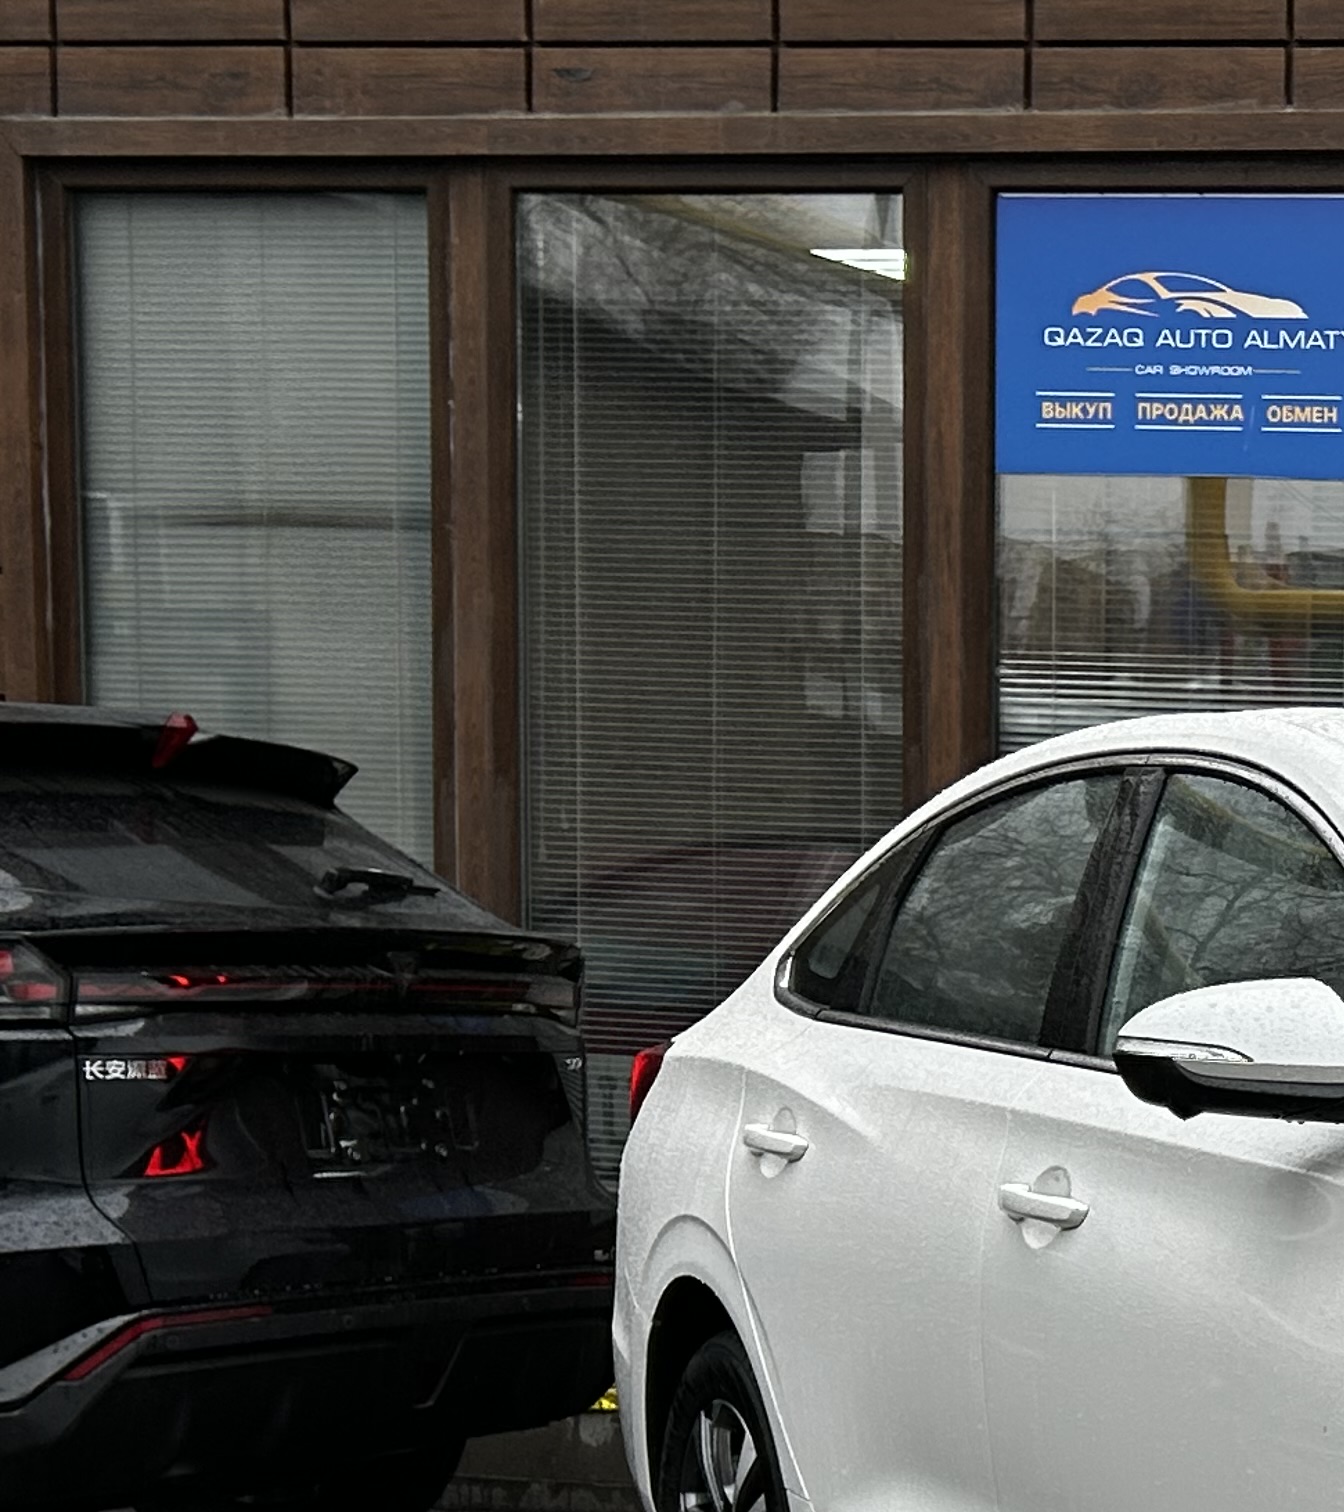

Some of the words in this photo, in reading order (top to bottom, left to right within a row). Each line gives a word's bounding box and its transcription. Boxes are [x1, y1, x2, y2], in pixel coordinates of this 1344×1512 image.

[1043, 327, 1145, 347] QAZAQ
[1155, 328, 1233, 349] AUTO
[1134, 363, 1164, 376] CAR
[1169, 364, 1253, 377] SHOWROOM
[1041, 401, 1113, 420] ВЫКУП
[1137, 402, 1244, 424] ПРОДАЖА
[1266, 404, 1338, 424] ОБМЕН
